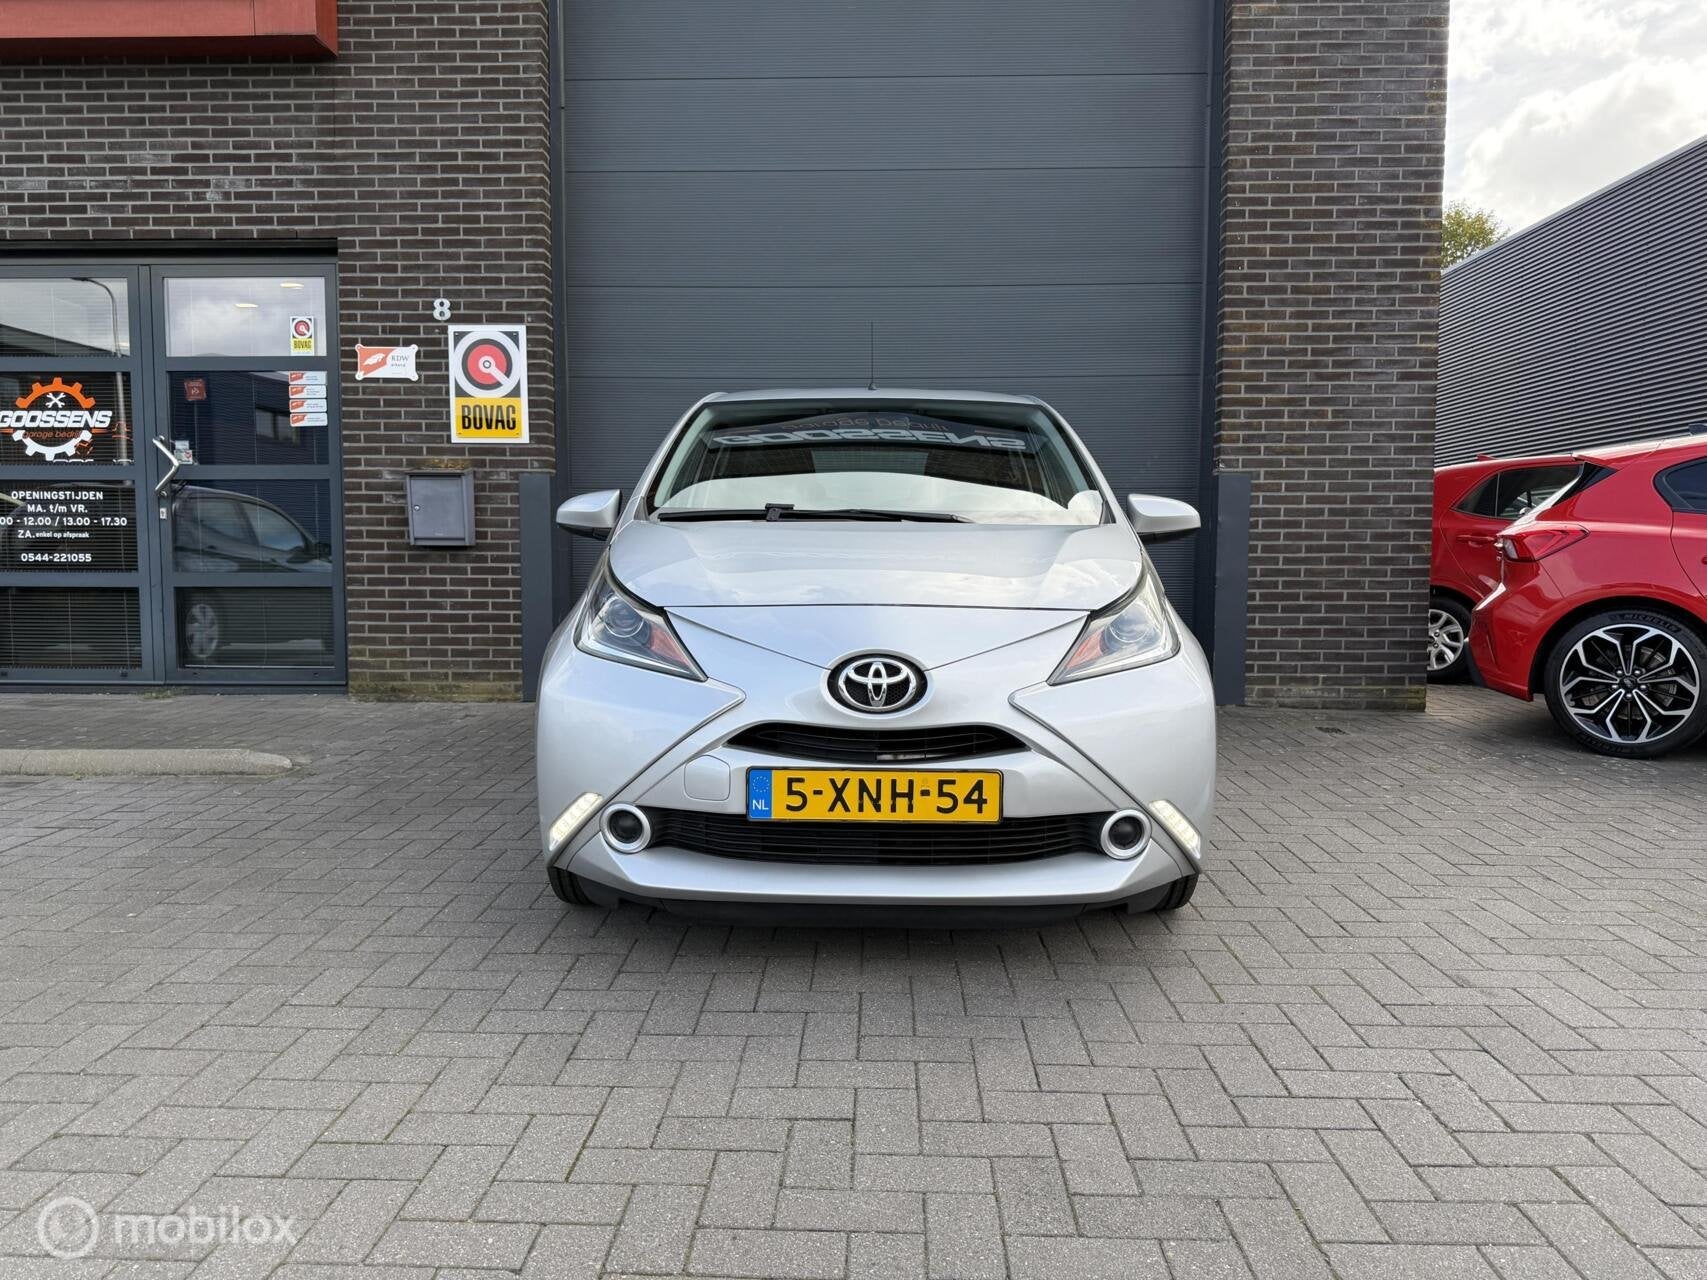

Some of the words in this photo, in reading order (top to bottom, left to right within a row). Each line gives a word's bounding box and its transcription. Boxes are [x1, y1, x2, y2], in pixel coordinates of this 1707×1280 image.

[433, 298, 451, 321] 8
[293, 340, 312, 349] BOVAG
[0, 410, 112, 428] GOOSSENS
[461, 404, 517, 431] BOVAG
[22, 430, 53, 440] garage
[11, 491, 104, 500] OPENINGSTIJDEN
[27, 504, 46, 513] MA.
[49, 504, 67, 514] t/m
[70, 504, 88, 513] VR.
[23, 516, 51, 526] 12.00
[63, 516, 90, 526] 13.00
[101, 516, 127, 526] 17.30
[63, 531, 90, 539] afspraak
[20, 553, 92, 562] 0544-221055
[785, 777, 988, 815] 5-XNH-54
[752, 799, 769, 810] NL
